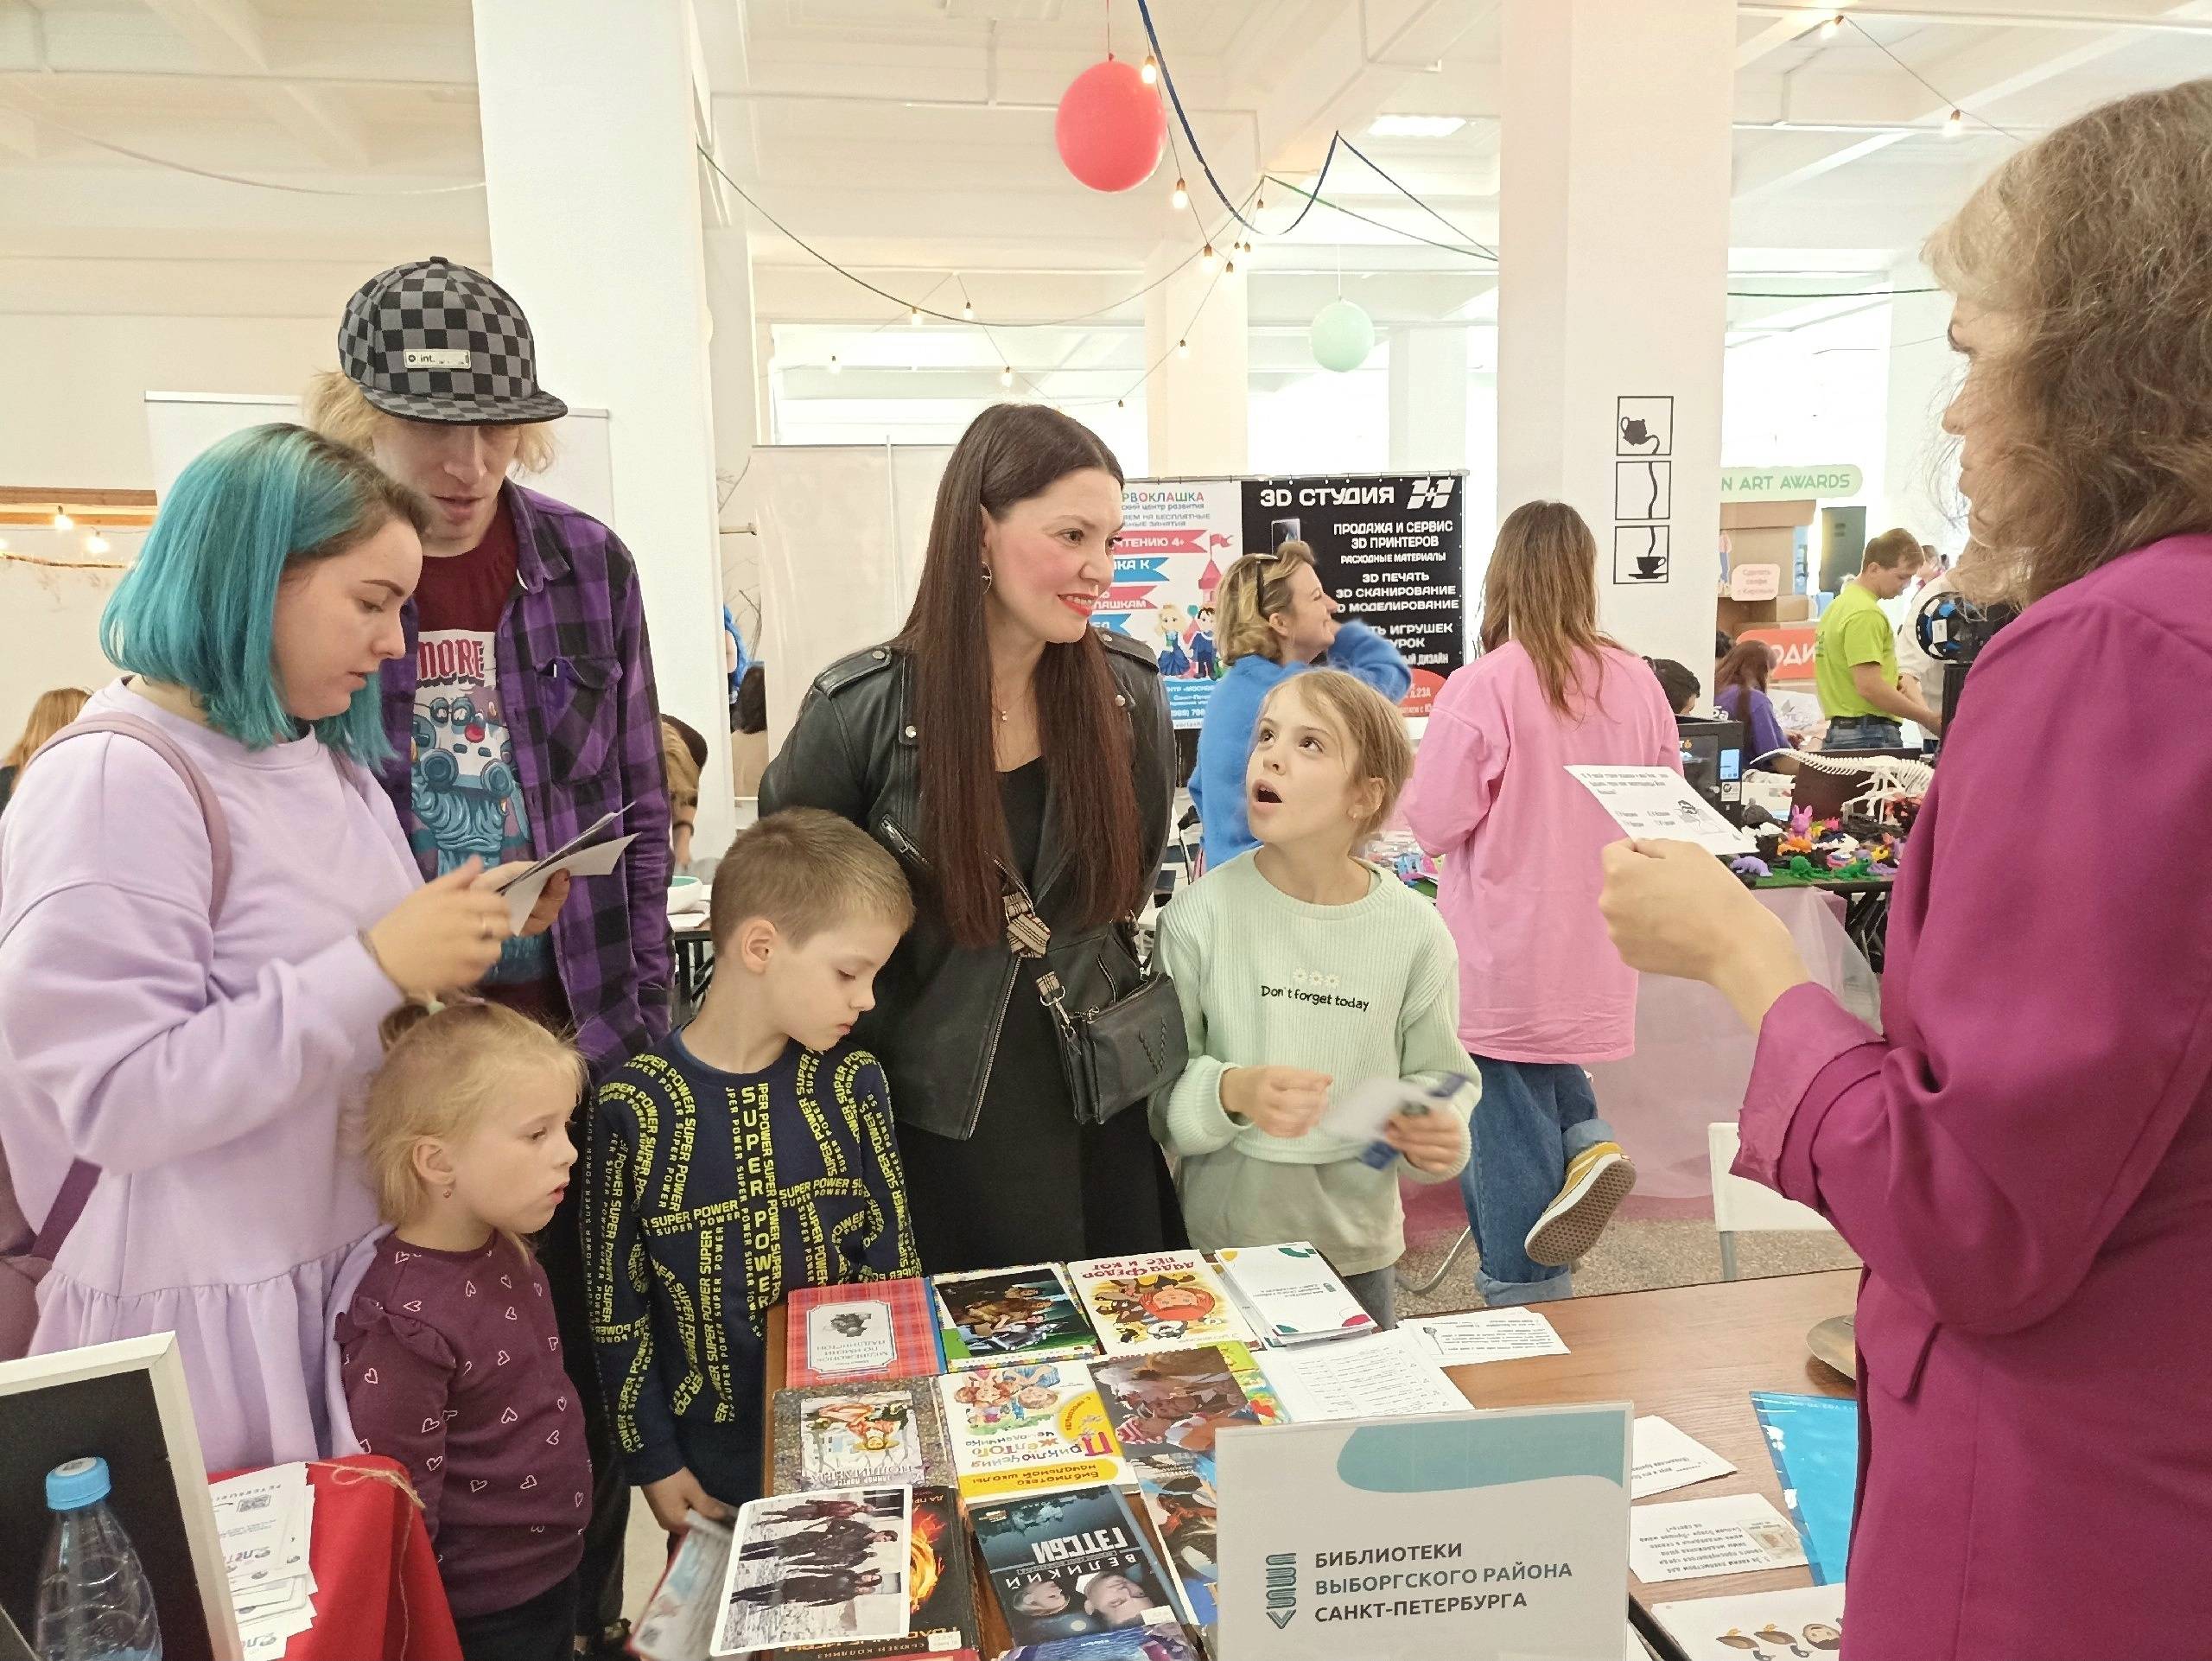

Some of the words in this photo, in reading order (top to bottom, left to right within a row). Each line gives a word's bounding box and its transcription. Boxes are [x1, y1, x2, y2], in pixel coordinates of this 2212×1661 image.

[1738, 475, 1774, 491] ART
[1780, 473, 1851, 490] AWARDS
[1122, 492, 1205, 502] РВОКЛАШКА
[1260, 488, 1293, 507] 3D
[1299, 487, 1395, 506] СТУДИЯ
[1333, 522, 1394, 535] ПРОДАЖА
[1395, 522, 1403, 533] И
[1406, 520, 1453, 533] СЕРВИС
[1351, 538, 1367, 549] 3D
[1370, 536, 1439, 549] ПРИНТЕРОВ
[1340, 554, 1393, 564] РАСХОДНЫЕ
[1394, 552, 1446, 563] МАТЕРИАЛЫ
[1362, 573, 1379, 583] 3D
[1382, 571, 1430, 582] ПЕЧАТЬ
[1094, 599, 1147, 609] ЛАШКАМ
[1335, 588, 1353, 599] 3D
[1355, 585, 1457, 598] СКАНИРОВАНИЕ
[1349, 599, 1460, 613] МОДЕЛИРОВАНИЕ
[1389, 622, 1453, 636] ИГРУШЕК
[1392, 638, 1426, 649] УРОК
[1261, 984, 1292, 998] Don't
[1294, 989, 1332, 1005] forget
[1335, 997, 1370, 1012] today
[666, 1067, 696, 1115] POWER
[679, 1117, 696, 1162] SUPER
[759, 1112, 773, 1157] POWER
[669, 1163, 689, 1212] POWER
[764, 1159, 778, 1198] SUPER
[779, 1181, 811, 1200] SUPER
[813, 1177, 850, 1190] POWER
[741, 1085, 764, 1198] SUPER
[753, 1210, 772, 1309] POWER
[651, 1211, 691, 1228] SUPER
[693, 1200, 739, 1220] POWER
[767, 1199, 780, 1242] POWER
[699, 1230, 713, 1275] SUPER
[699, 1277, 713, 1322] POWER
[1031, 1526, 1128, 1564] ГЭТСБИ
[1315, 1543, 1463, 1569] БИБЛИОТЕКИ
[1005, 1554, 1137, 1590] ВЕЛИКИЙ
[1315, 1568, 1478, 1596] ВЫБОРГСКОГО
[1483, 1561, 1573, 1583] РАЙОНА
[1314, 1592, 1528, 1623] САНКТ-ПЕТЕРБУРГА
